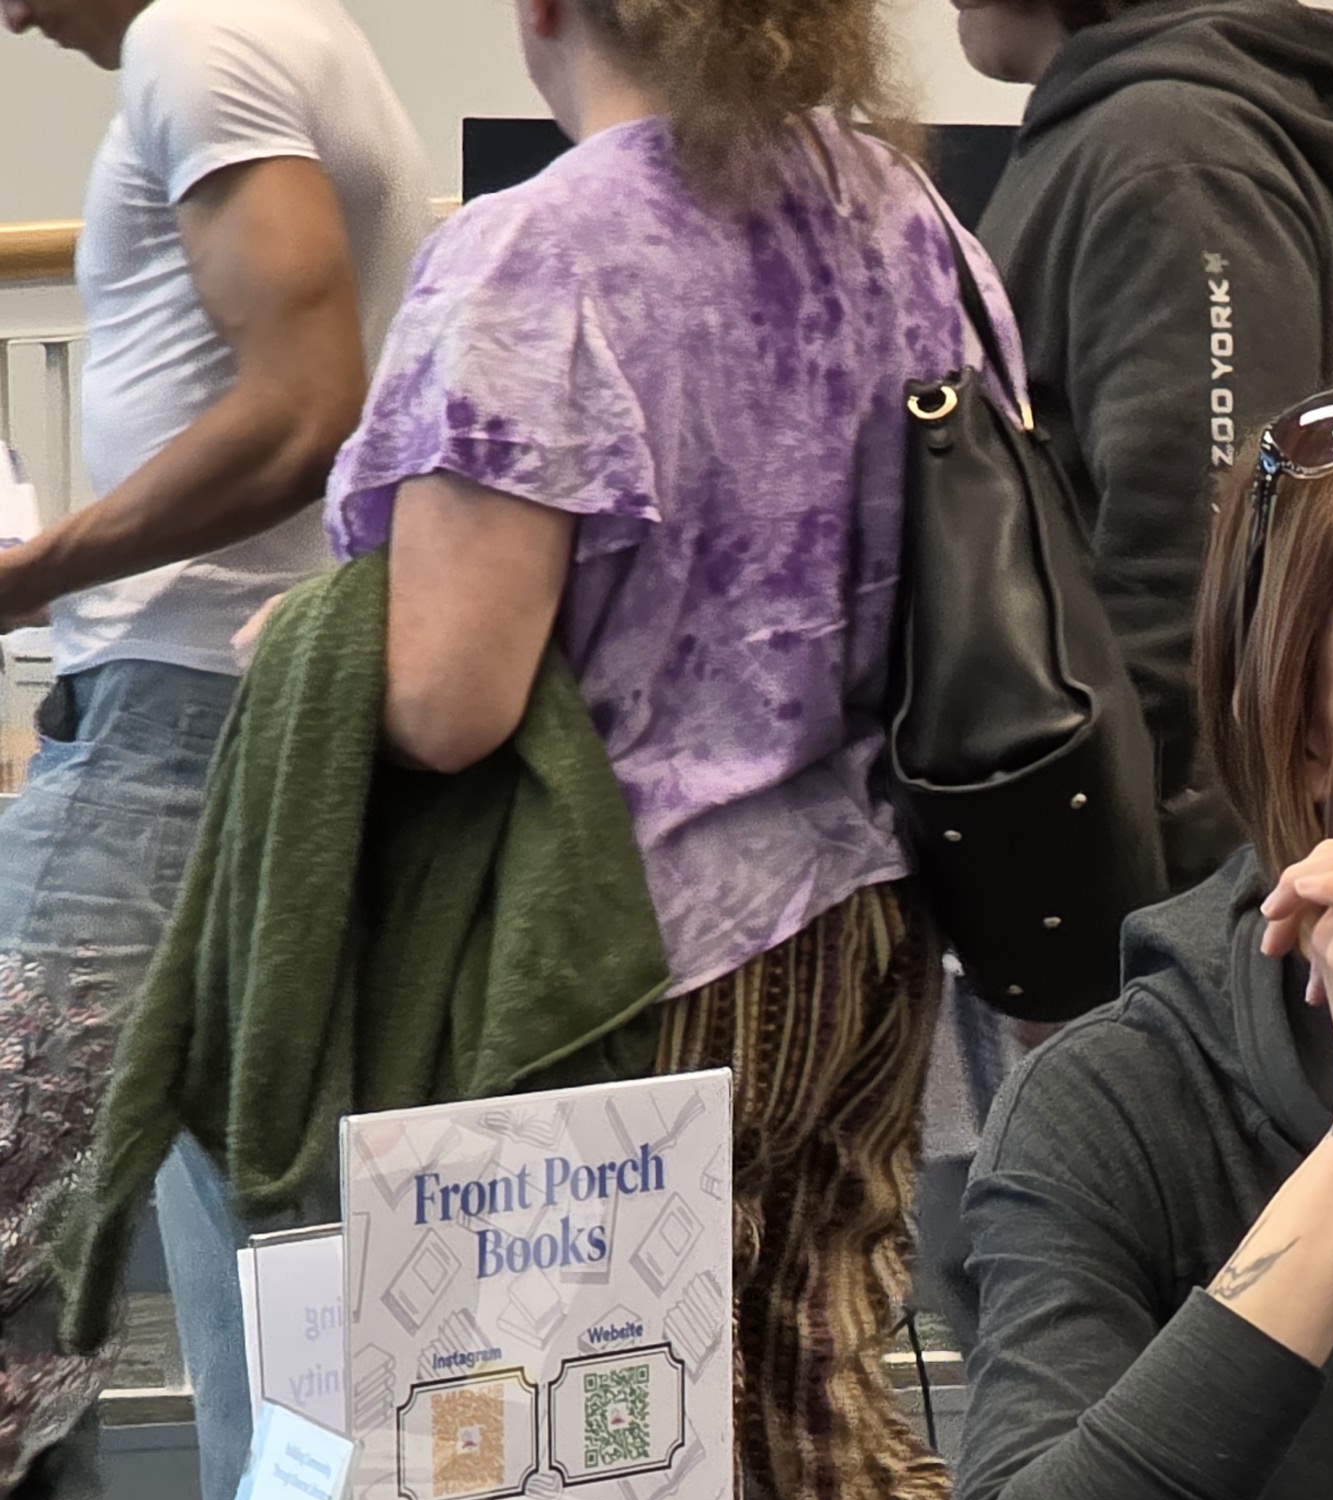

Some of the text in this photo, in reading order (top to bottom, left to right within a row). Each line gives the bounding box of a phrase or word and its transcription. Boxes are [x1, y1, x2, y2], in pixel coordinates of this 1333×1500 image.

[1208, 279, 1235, 467] ZOO YORK
[414, 1143, 665, 1226] Front Porch
[476, 1217, 607, 1280] Books
[432, 1345, 502, 1370] Instagram
[587, 1321, 644, 1344] Website
